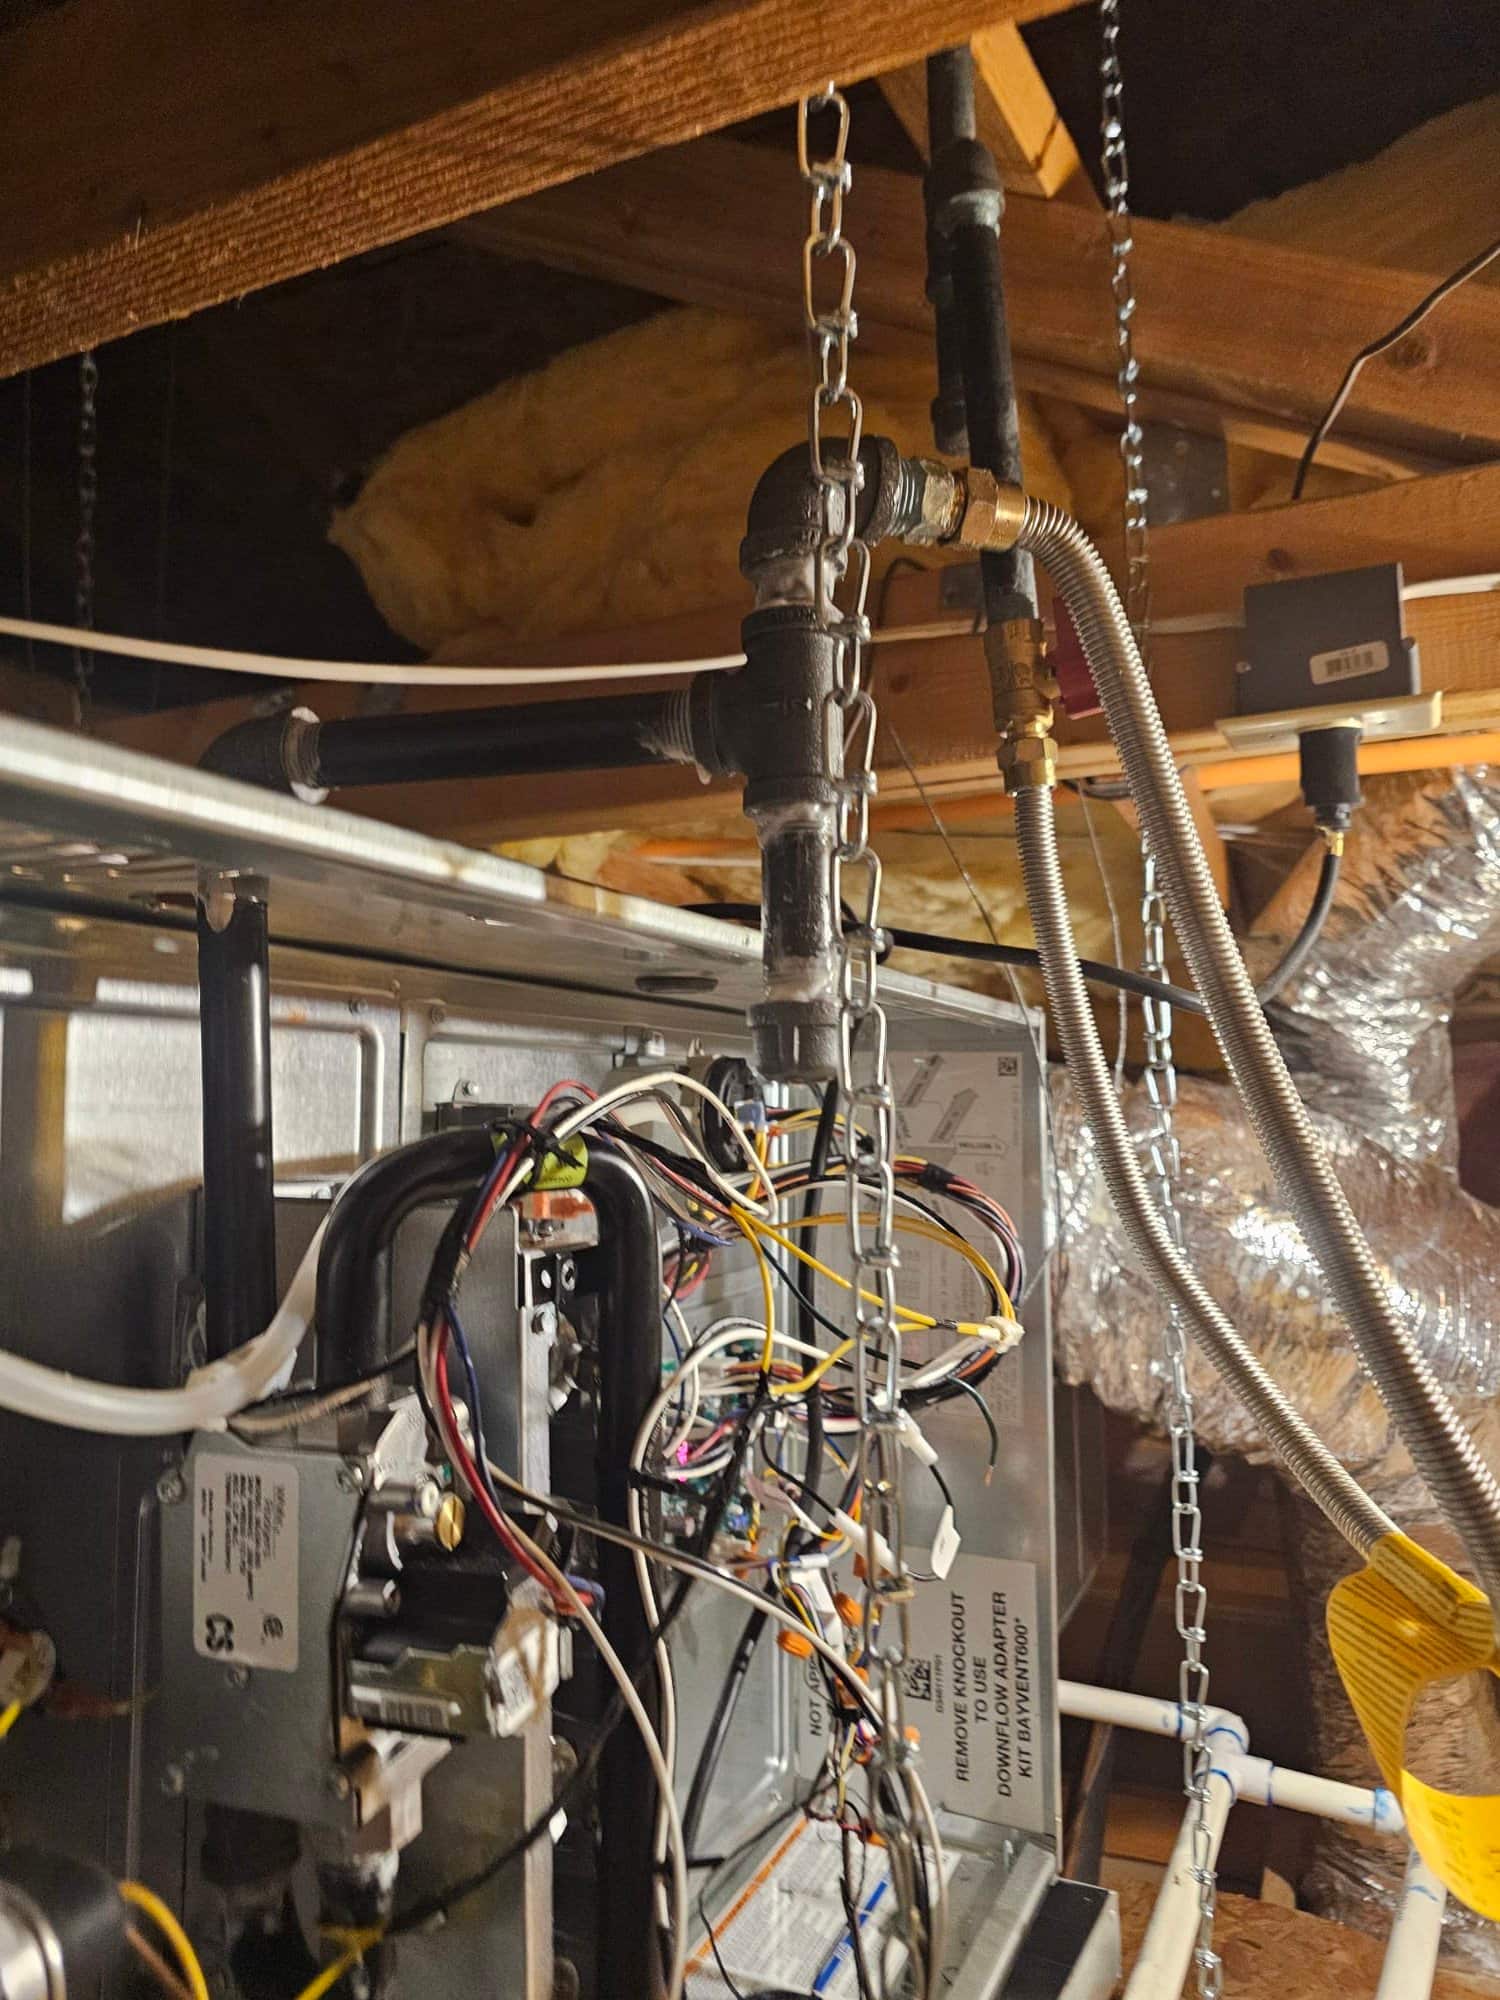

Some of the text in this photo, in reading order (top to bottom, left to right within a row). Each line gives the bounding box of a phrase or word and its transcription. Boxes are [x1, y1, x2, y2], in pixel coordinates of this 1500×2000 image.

[809, 1699, 822, 1737] NOT
[951, 1592, 970, 1781] REMOVE KNOCKOUT
[973, 1657, 988, 1724] TO USE
[992, 1592, 1013, 1798] DOWNFLOW ADAPTER
[1017, 1744, 1032, 1778] KIT
